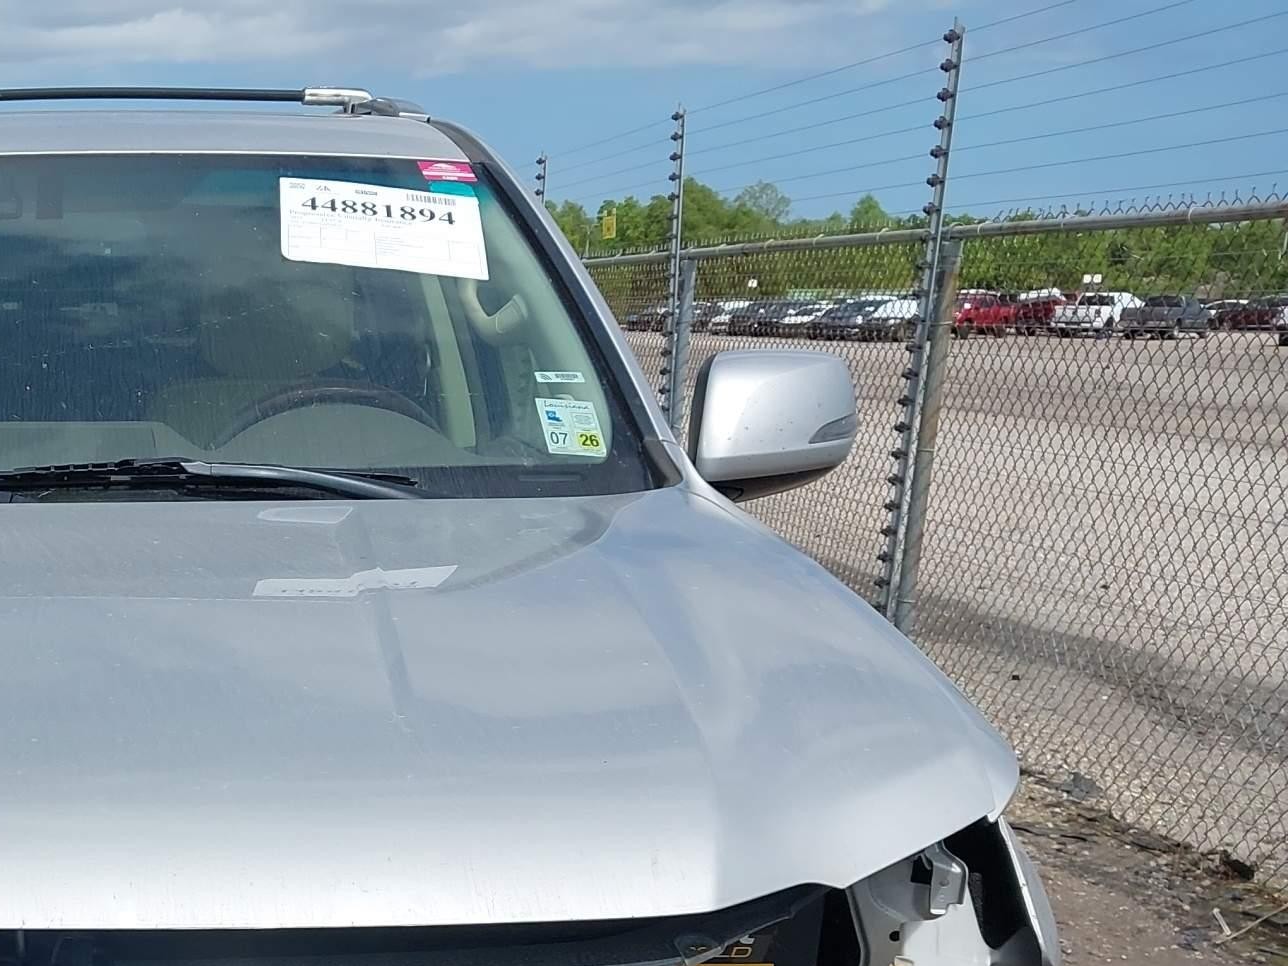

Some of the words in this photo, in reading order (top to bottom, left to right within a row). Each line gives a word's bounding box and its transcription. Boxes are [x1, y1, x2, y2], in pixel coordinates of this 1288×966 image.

[301, 196, 455, 225] 44881894
[550, 431, 568, 445] 07
[579, 433, 600, 447] 26
